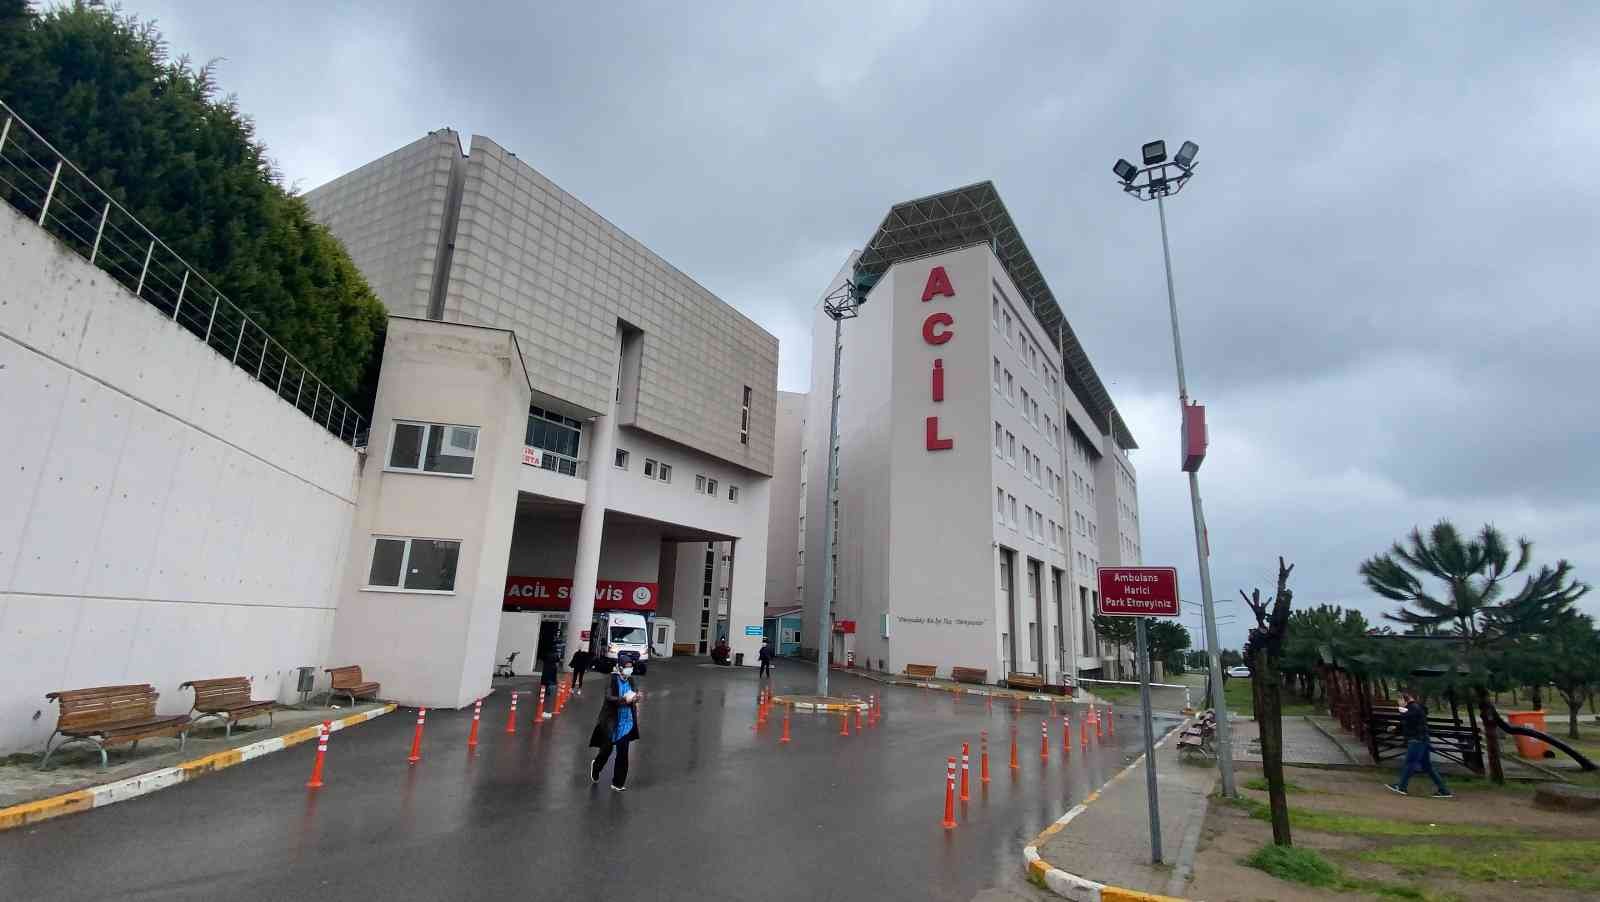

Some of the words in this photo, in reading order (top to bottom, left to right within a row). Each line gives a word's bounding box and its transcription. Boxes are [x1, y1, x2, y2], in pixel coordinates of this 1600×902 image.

[921, 266, 955, 451] ACİL
[1114, 573, 1159, 582] Ambulans
[508, 581, 550, 598] ACİL
[557, 584, 625, 601] SVİS
[1124, 585, 1150, 595] Harici
[1105, 597, 1125, 607] Park
[1126, 598, 1172, 609] Etmeyiniz
